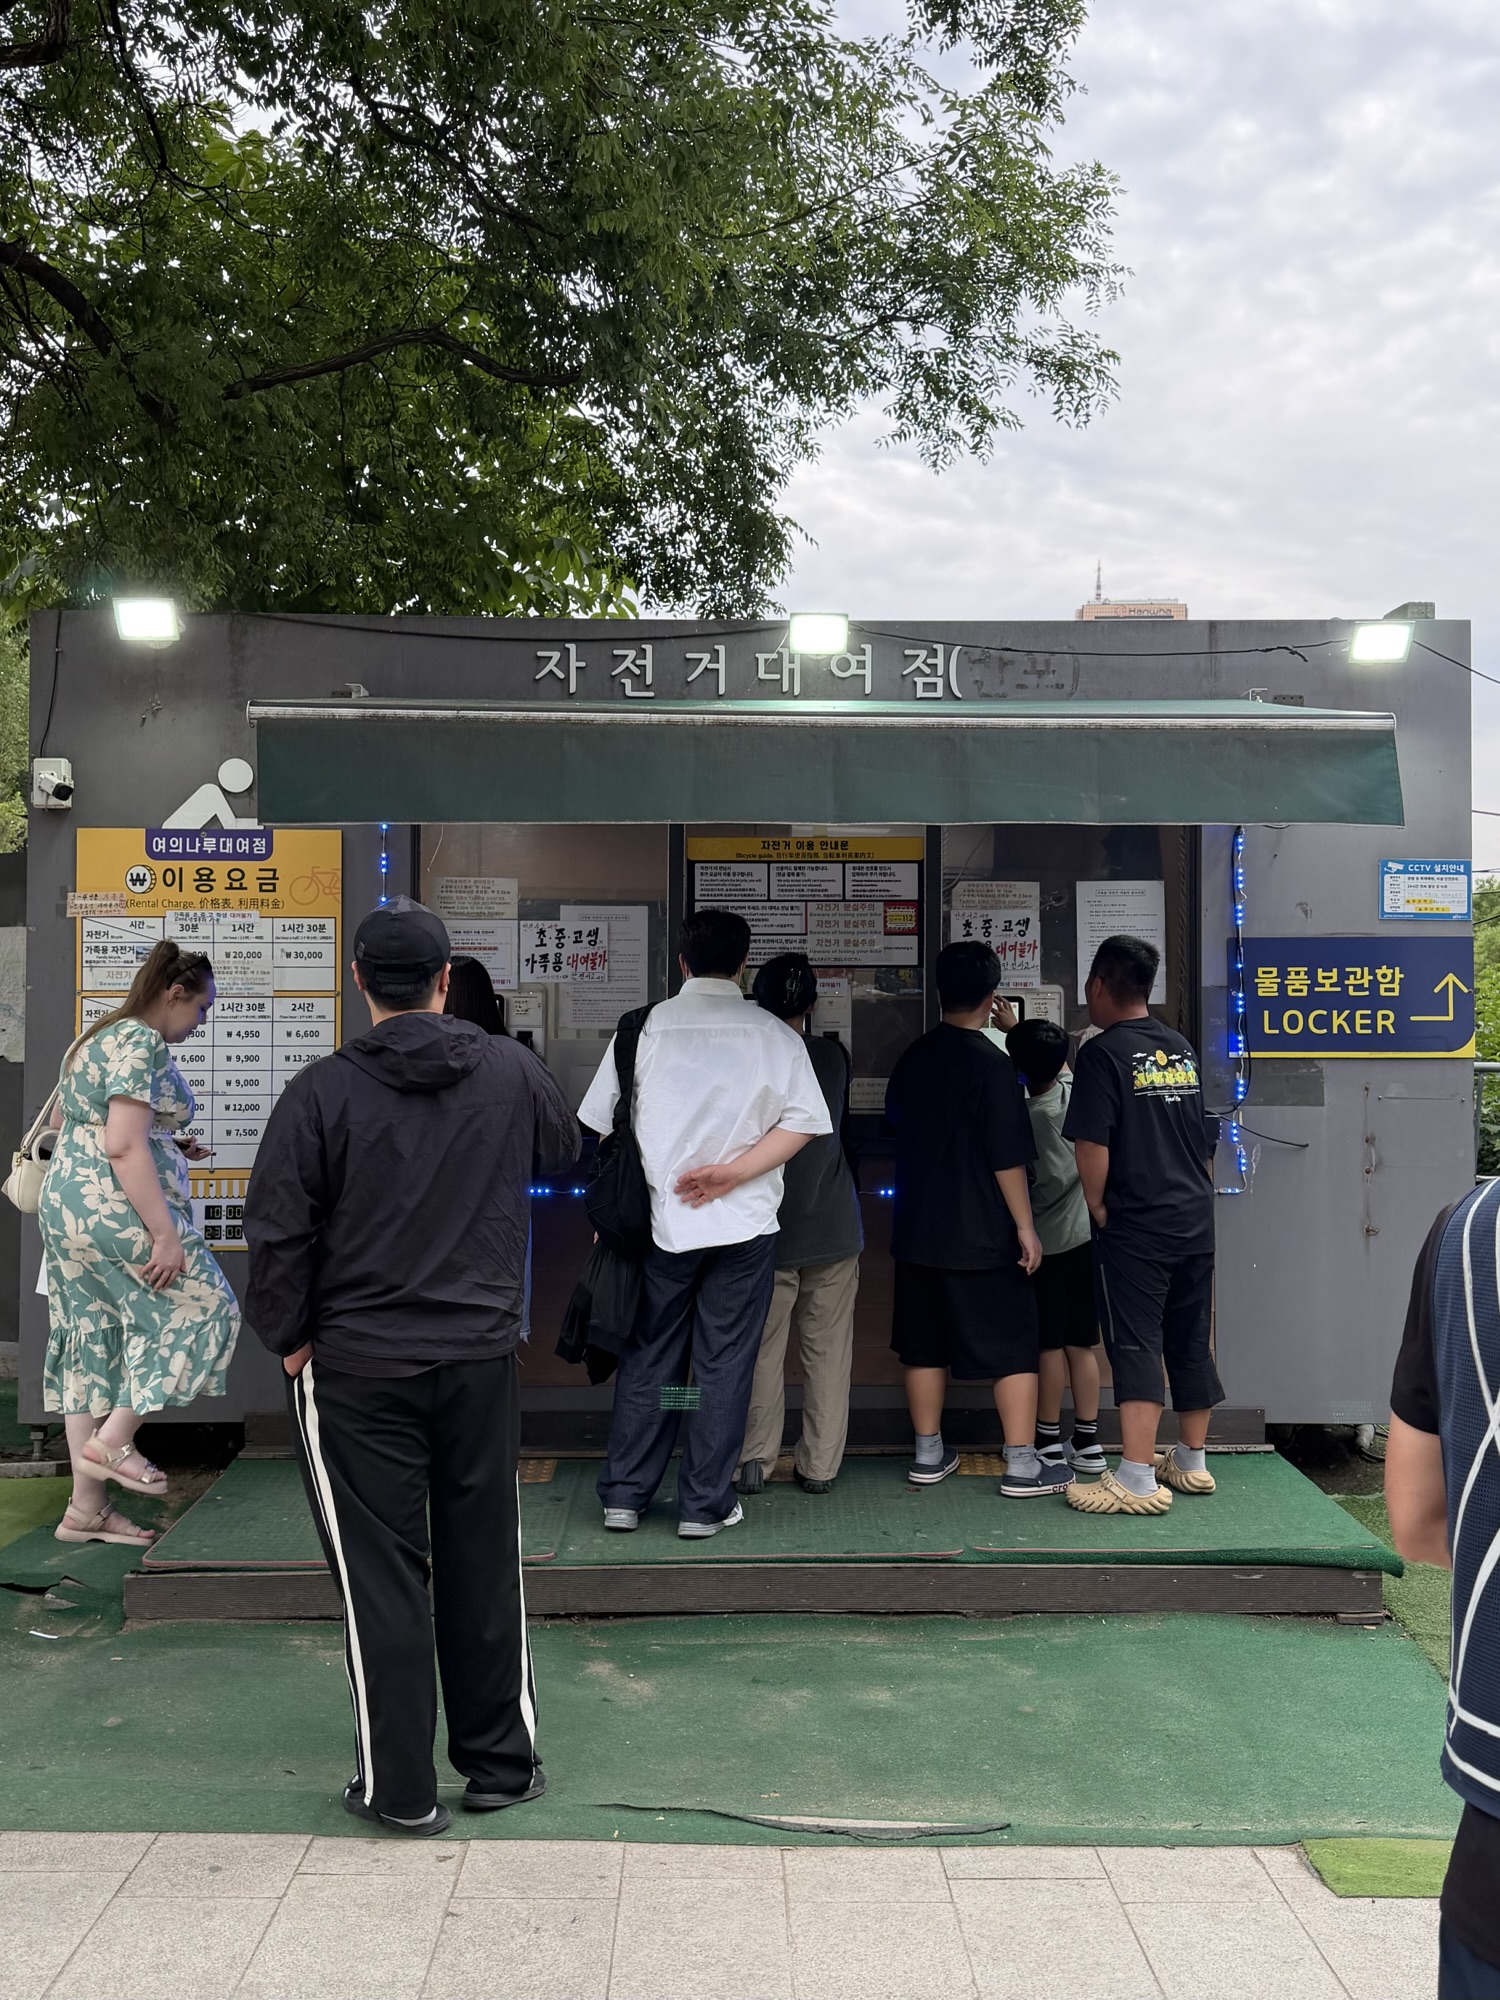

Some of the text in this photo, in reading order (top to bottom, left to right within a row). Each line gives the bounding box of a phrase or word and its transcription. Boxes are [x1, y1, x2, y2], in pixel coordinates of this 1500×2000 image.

[1128, 608, 1172, 616] Hanwha
[152, 836, 267, 855] 여의나루대여점
[761, 840, 849, 851] 자전거 이용 안내문
[1408, 864, 1464, 873] CCTV 설치안내
[162, 867, 280, 893] 이용요금
[126, 898, 285, 910] (Rental Charge, 价格表, 利用料金)
[816, 903, 876, 911] 자전거 분실주의
[903, 914, 914, 922] 112
[129, 920, 145, 930] 시간
[179, 923, 200, 933] 30분
[231, 923, 255, 933] 1시간
[281, 923, 327, 933] 1시간 30분
[816, 920, 876, 928] 자전거 분실주의
[85, 930, 110, 940] 자전거
[816, 939, 876, 947] 자전거 분실주의
[85, 945, 135, 955] 가족용 자전거
[996, 940, 1039, 961] 대여불가
[232, 951, 262, 961] 20,000
[293, 951, 323, 961] 30,000
[525, 952, 564, 974] 가족용
[566, 950, 608, 971] 대여불가
[1254, 965, 1405, 997] 물품보관함
[220, 1002, 266, 1012] 1시간 30분
[291, 1002, 315, 1012] 2시간
[1263, 1009, 1396, 1034] LOCKER
[235, 1030, 260, 1040] 4,950
[295, 1030, 320, 1040] 6,600
[180, 1054, 206, 1064] 6,600
[235, 1054, 260, 1064] 9,900
[292, 1054, 321, 1064] 13,200
[235, 1079, 260, 1089] 9,000
[232, 1103, 260, 1113] 12,000
[180, 1128, 205, 1137] 5,000
[234, 1129, 259, 1139] 7,500
[210, 1207, 242, 1218] 10:00
[205, 1226, 242, 1239] 23:00
